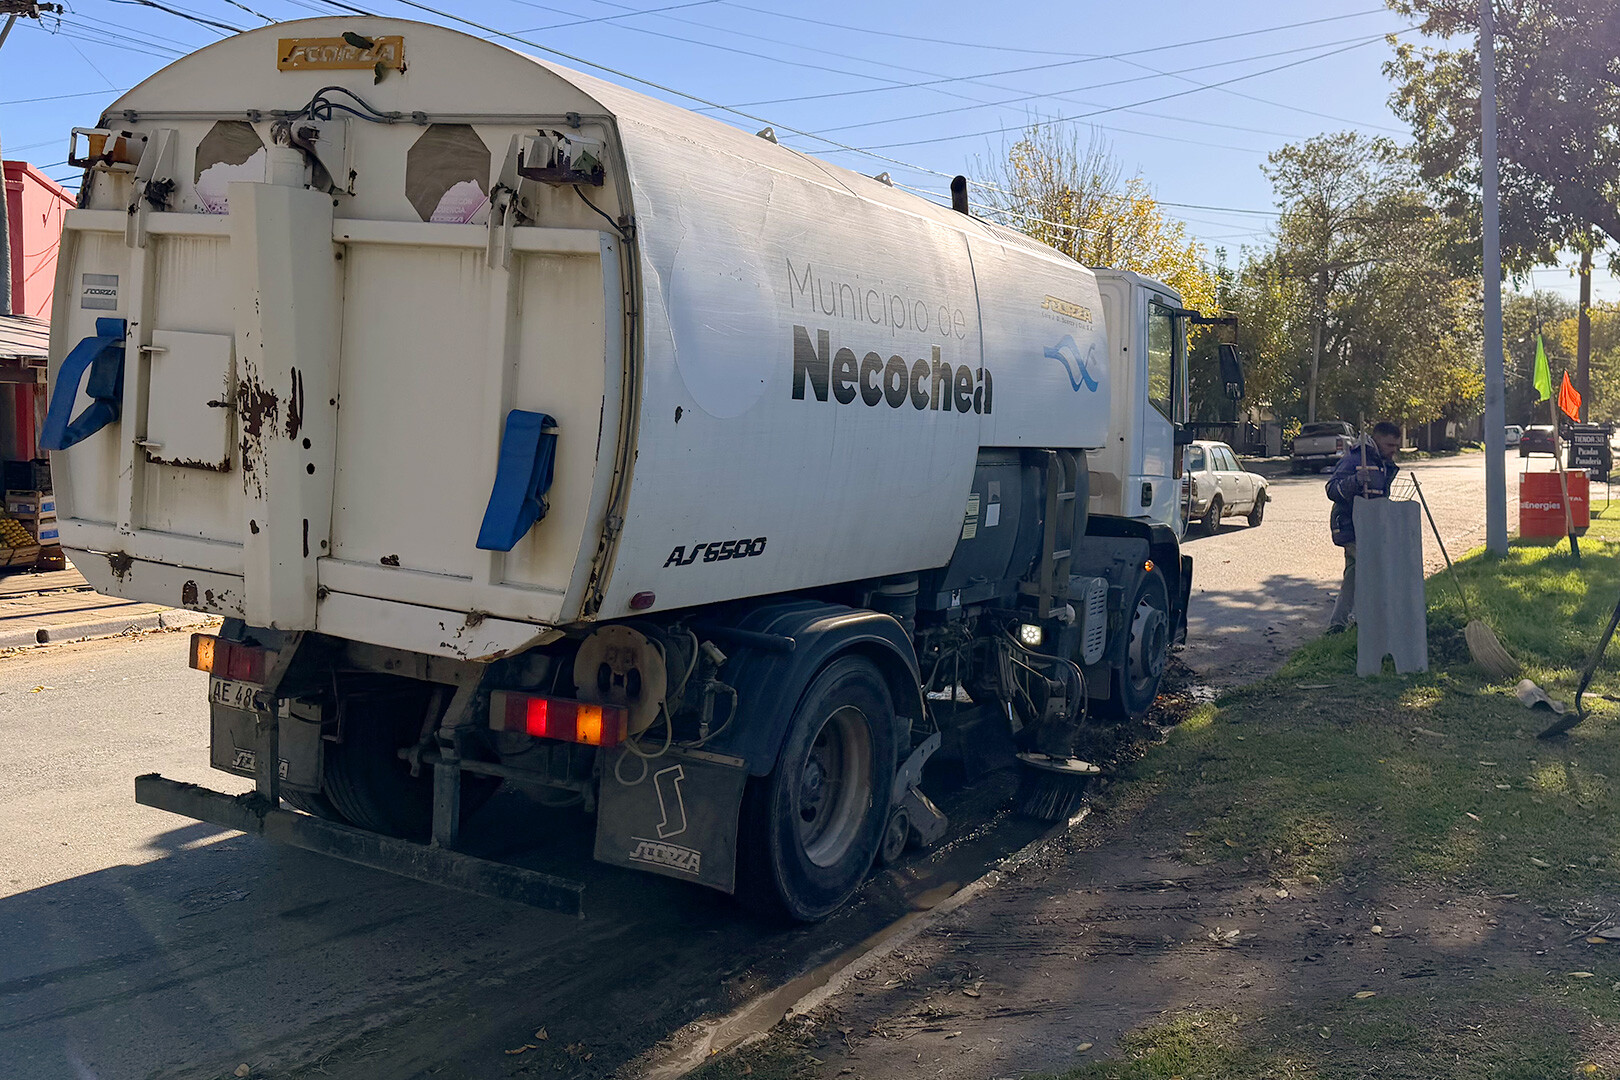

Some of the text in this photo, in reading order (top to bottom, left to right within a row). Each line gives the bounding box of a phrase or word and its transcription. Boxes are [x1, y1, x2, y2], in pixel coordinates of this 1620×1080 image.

[283, 44, 395, 62] SCORZA
[83, 288, 117, 296] SCORZA
[787, 257, 966, 340] Municipio de
[792, 324, 993, 415] Necochea
[213, 681, 231, 702] AE
